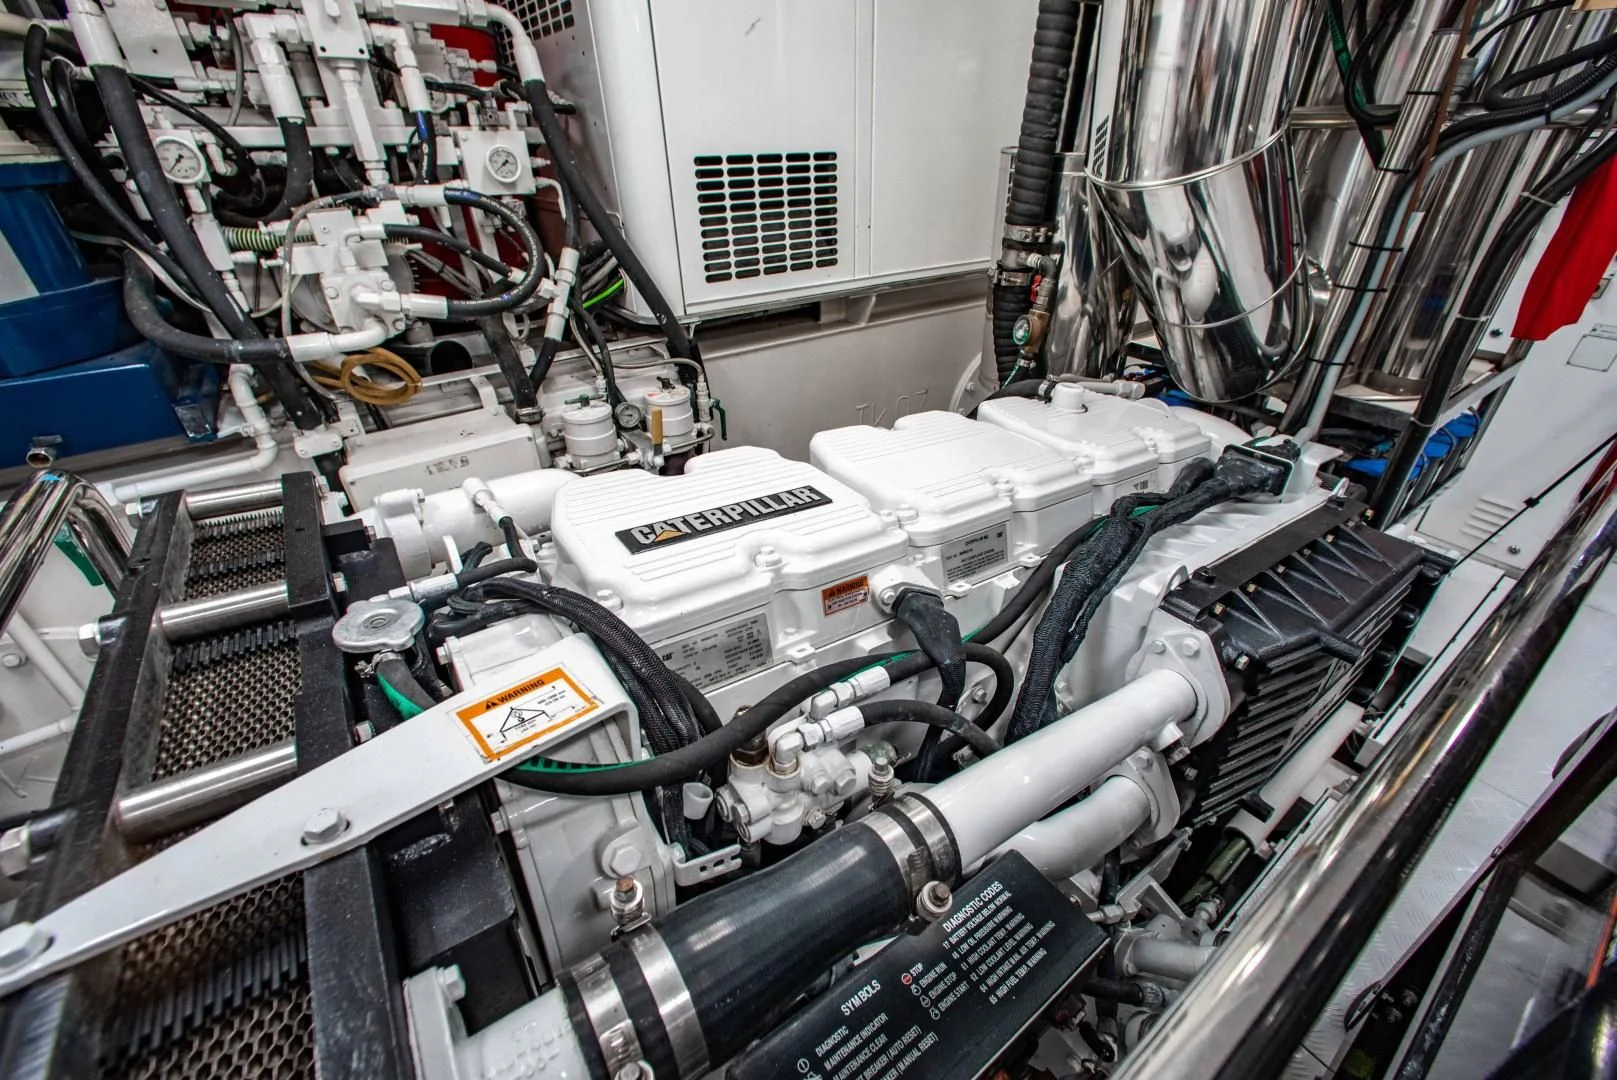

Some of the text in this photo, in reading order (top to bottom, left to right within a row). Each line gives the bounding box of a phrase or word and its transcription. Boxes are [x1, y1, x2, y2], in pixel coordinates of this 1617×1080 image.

[630, 487, 821, 544] CATERPILLAR
[497, 679, 545, 703] WARNING
[942, 881, 1003, 933] DIAGNOSTIC CODES
[942, 890, 1012, 949] 17 BATTERY VOLTAGE BELOW NORMAL
[957, 942, 970, 955] LOW
[967, 936, 977, 947] OIL
[973, 920, 997, 941] PRESSURE
[993, 905, 1013, 924] WARNING
[960, 912, 1025, 971] 61 HIGH COOLANT TEMP. WARNING
[969, 922, 1034, 982] 62 LOW COOLANT LEVEL WARNING
[979, 983, 988, 993] 64
[985, 972, 999, 987] HIGH
[995, 960, 1013, 978] INTAKE
[1019, 945, 1029, 956] AIR
[1025, 936, 1040, 949] TEMP.
[1035, 920, 1056, 939] WARNING
[909, 962, 923, 977] STOP
[919, 961, 948, 988] ENGINE RUN
[928, 971, 957, 1000] ENGINE STOP
[988, 947, 1047, 1005] 65 HIGH FUEL TEMP. WARNING
[840, 979, 881, 1016] SYMBOLS
[938, 981, 970, 1012] ENGINE START
[815, 1025, 849, 1057] DIAGNOSTIC
[823, 1012, 888, 1071] MAINTENANCE INDICATOR
[863, 1024, 922, 1080] BREAKER (AUTO RESET)
[869, 1033, 888, 1053] CLEAR
[895, 1047, 922, 1075] (MANUAL
[918, 1031, 939, 1052] RESET)
